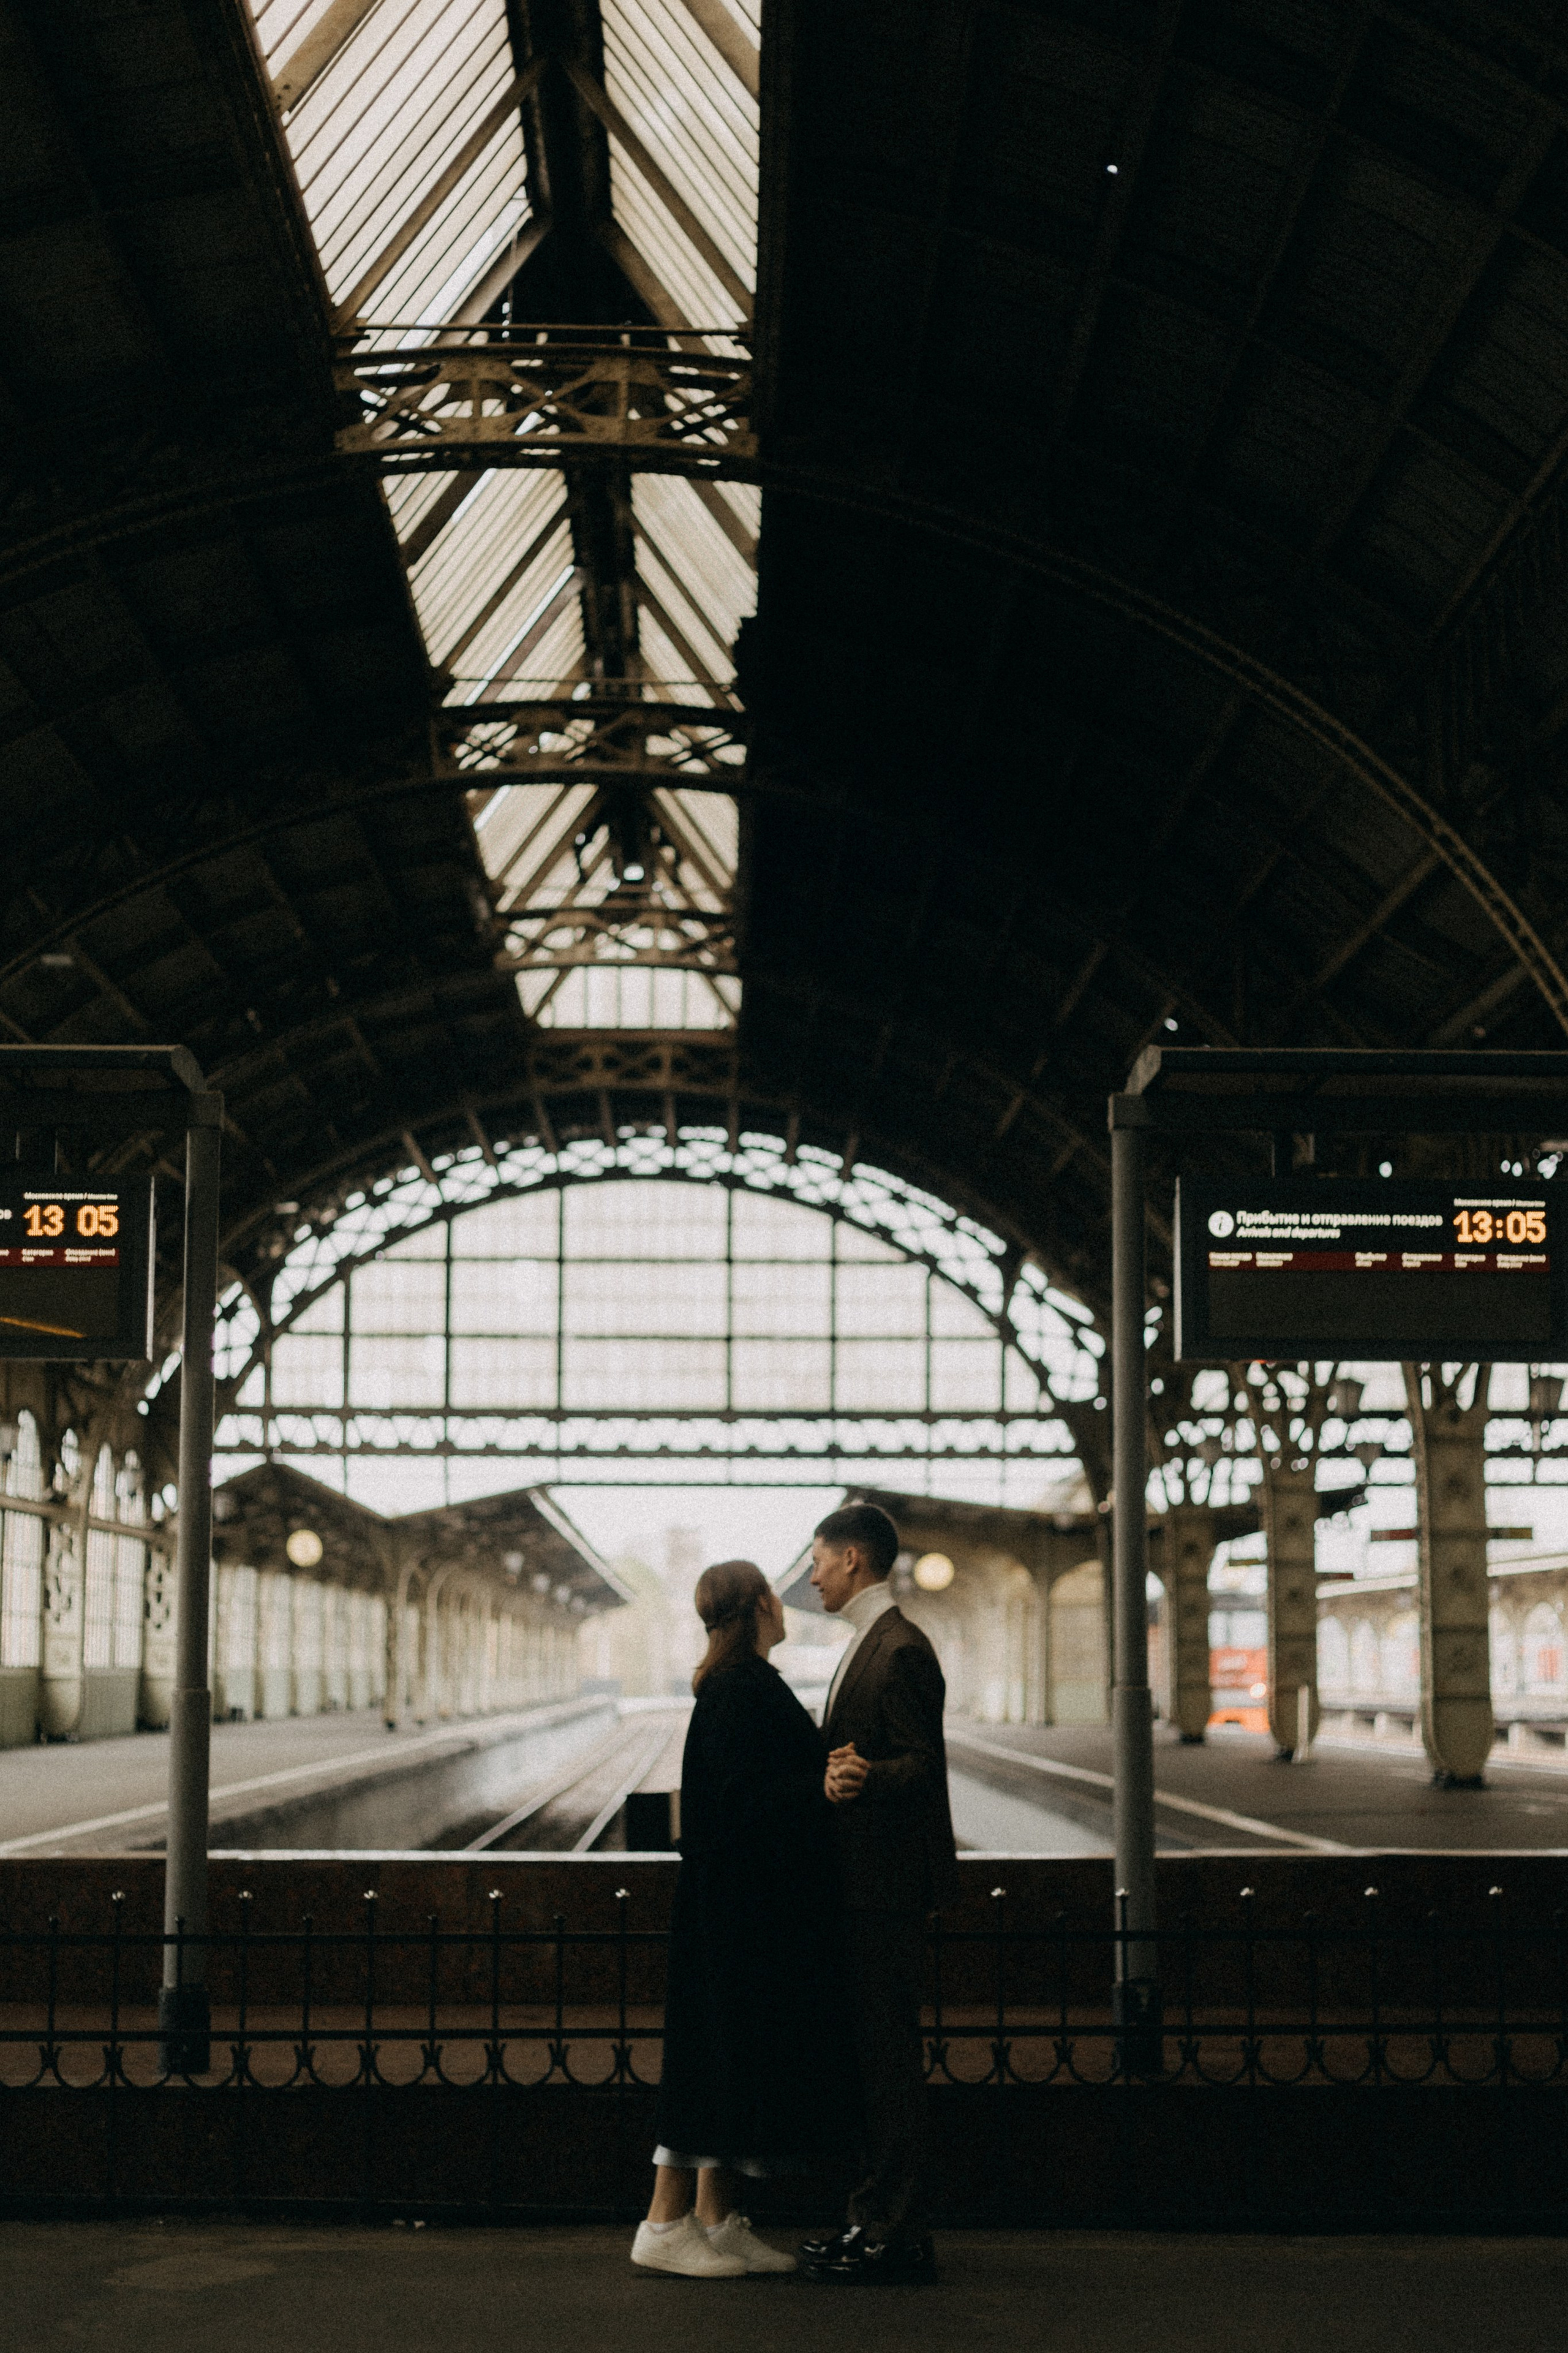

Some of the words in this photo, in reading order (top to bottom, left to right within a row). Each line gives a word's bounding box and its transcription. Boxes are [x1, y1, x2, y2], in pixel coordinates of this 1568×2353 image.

[23, 1205, 64, 1236] 13
[77, 1205, 119, 1236] 05
[1236, 1210, 1300, 1227] Прибытие
[1301, 1214, 1310, 1225] и
[1311, 1214, 1391, 1228] отправление
[1392, 1214, 1443, 1228] поездов
[1453, 1210, 1546, 1243] 13:05
